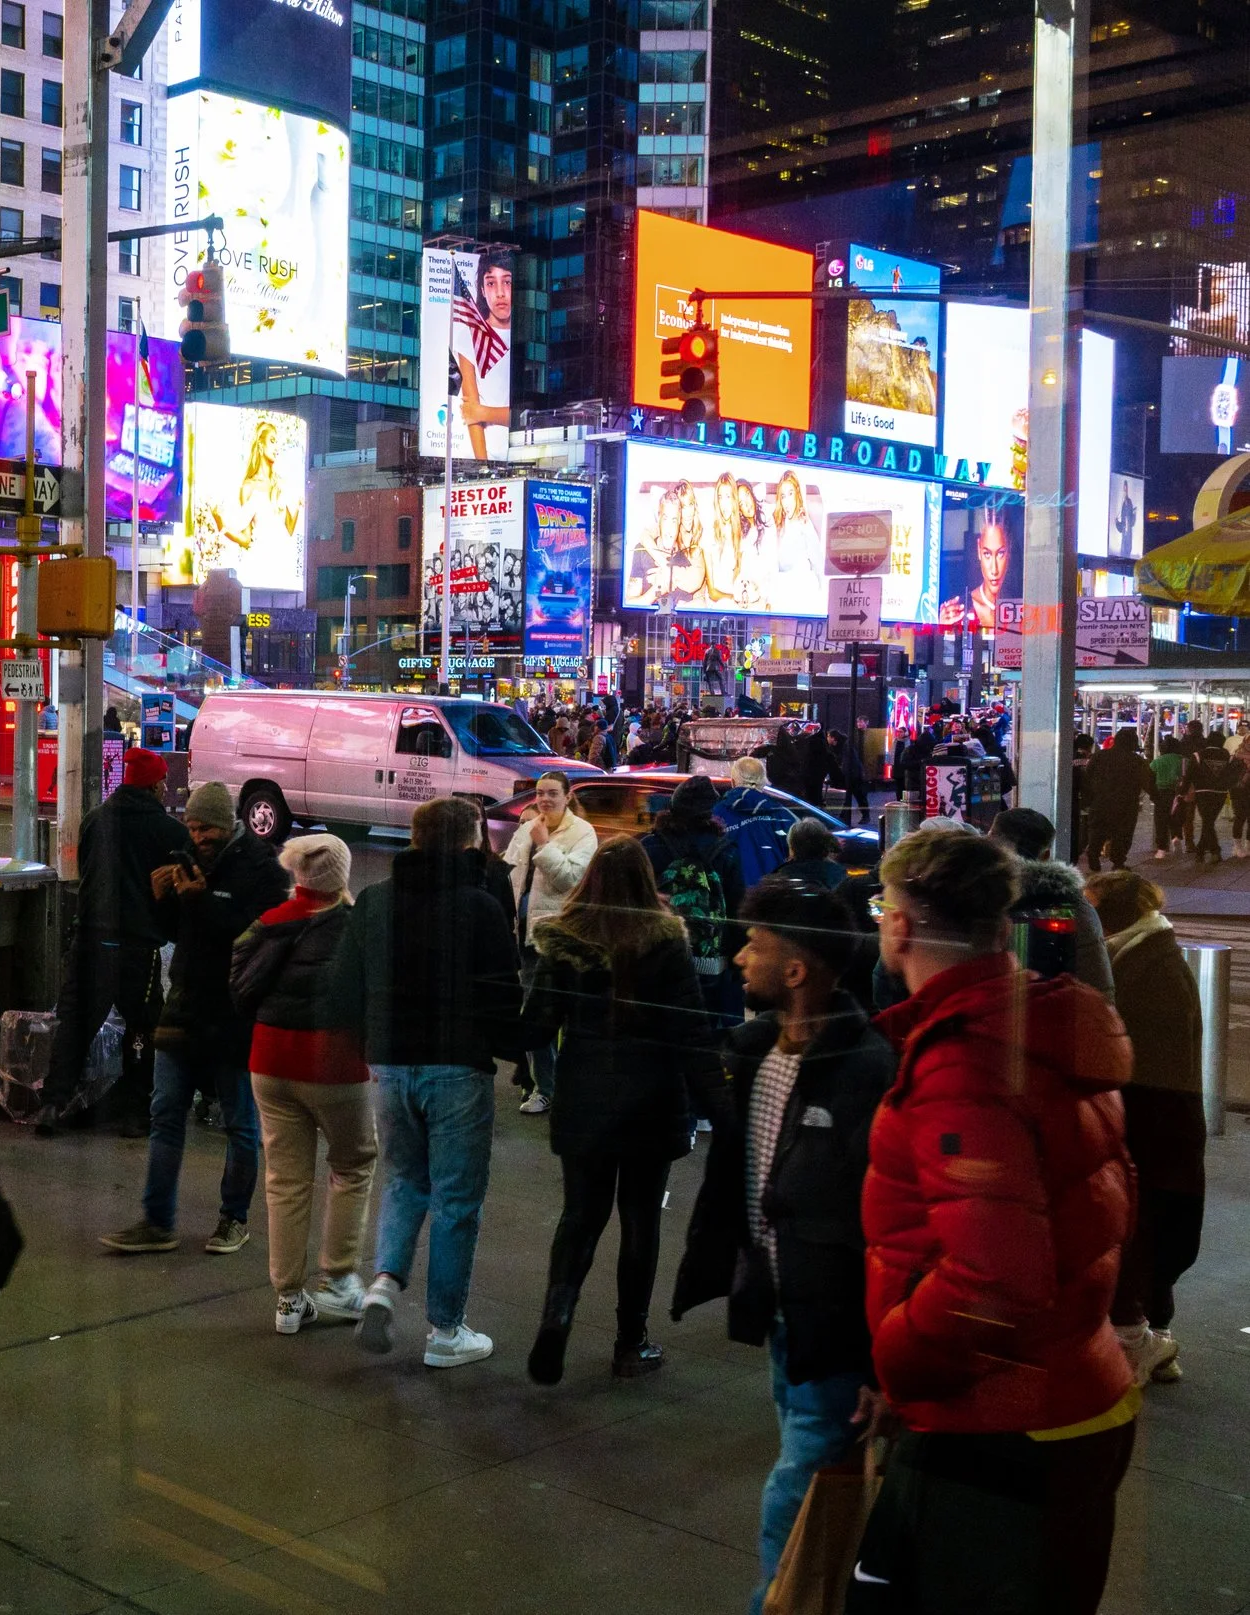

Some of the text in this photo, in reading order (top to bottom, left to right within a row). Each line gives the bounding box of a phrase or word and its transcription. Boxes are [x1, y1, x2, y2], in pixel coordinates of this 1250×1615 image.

[303, 0, 344, 27] Hilton
[174, 146, 190, 218] RUSH
[219, 248, 298, 279] OVE RUSH
[851, 410, 895, 430] Life's Good
[803, 432, 992, 484] BROADWAY
[487, 486, 507, 501] OF
[472, 501, 513, 516] YEAR!
[838, 523, 880, 535] DO NOT
[839, 552, 876, 563] ENTER
[846, 582, 864, 594] ALL
[839, 596, 871, 608] TRAFFIC
[1081, 599, 1147, 622] SLAM
[3, 661, 40, 679] PEDESTRIAN
[399, 657, 432, 669] GIFTS
